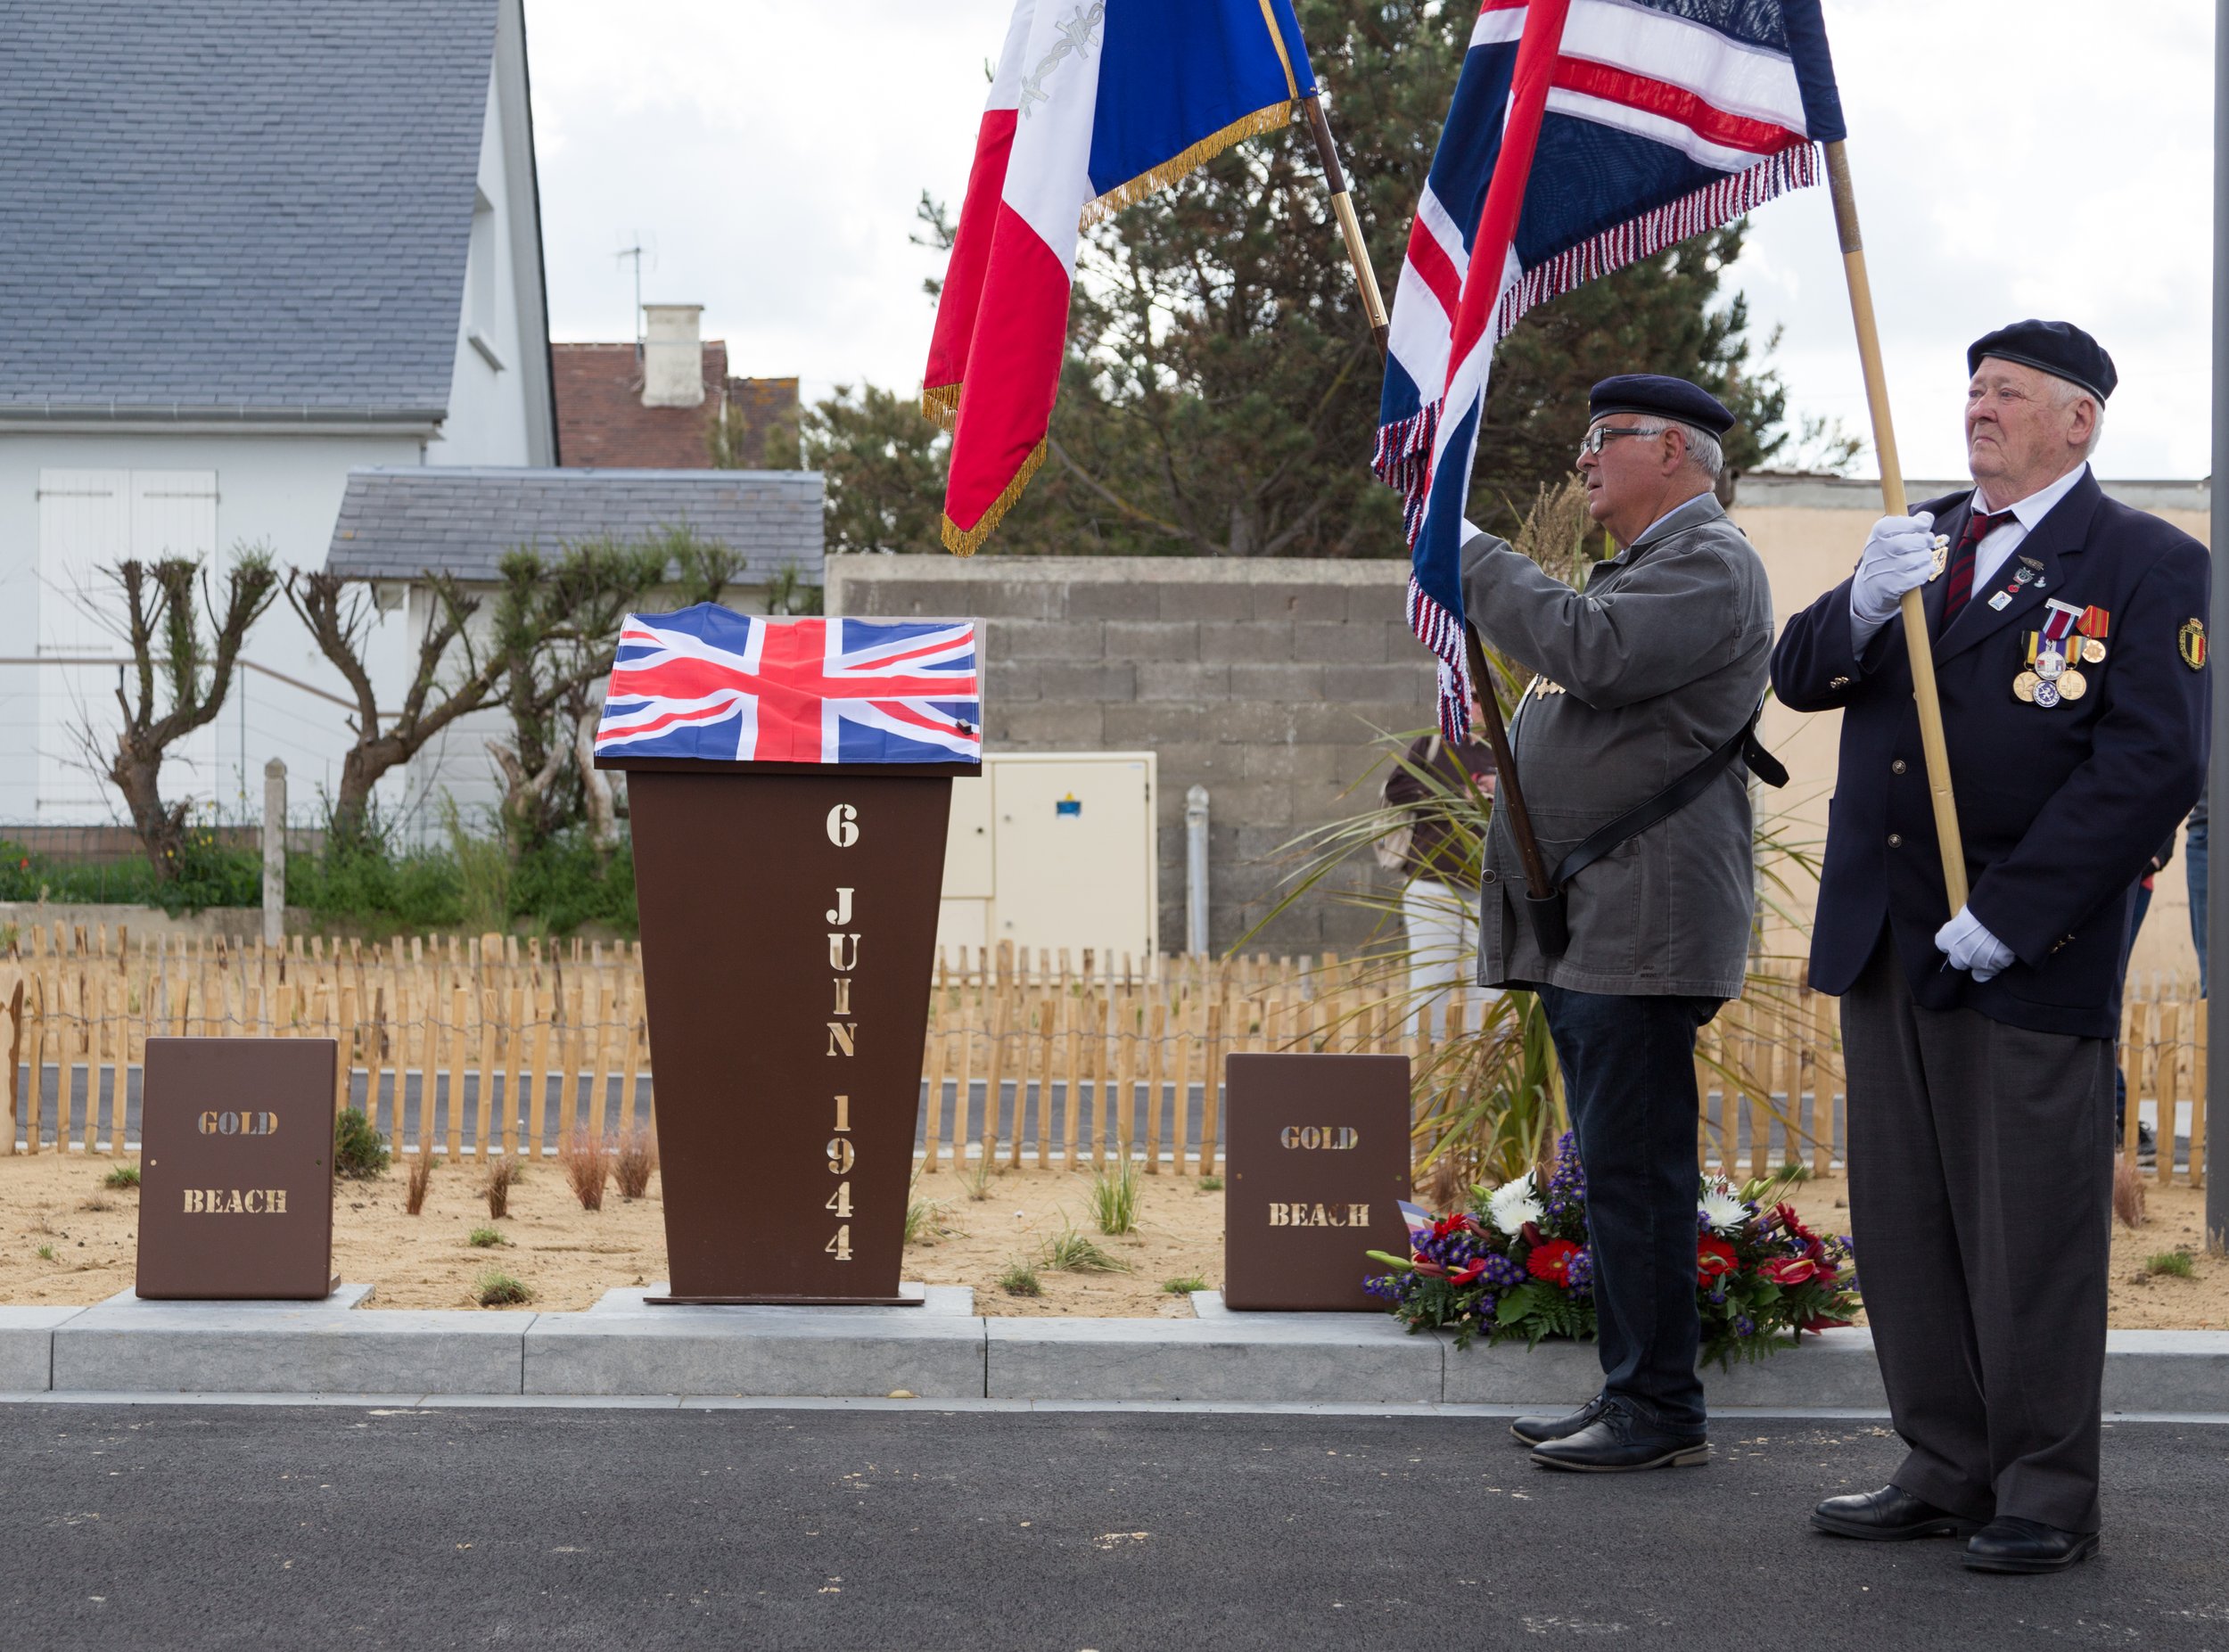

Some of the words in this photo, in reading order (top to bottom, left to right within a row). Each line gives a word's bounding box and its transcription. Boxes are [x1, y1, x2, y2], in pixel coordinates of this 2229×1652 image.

[826, 803, 860, 848] 6
[825, 887, 862, 1057] JUIN
[198, 1111, 278, 1134] GOLD
[1281, 1126, 1359, 1150] GOLD
[824, 1095, 855, 1262] 1944
[183, 1188, 288, 1213] BEACH
[1268, 1202, 1370, 1227] BEACH
